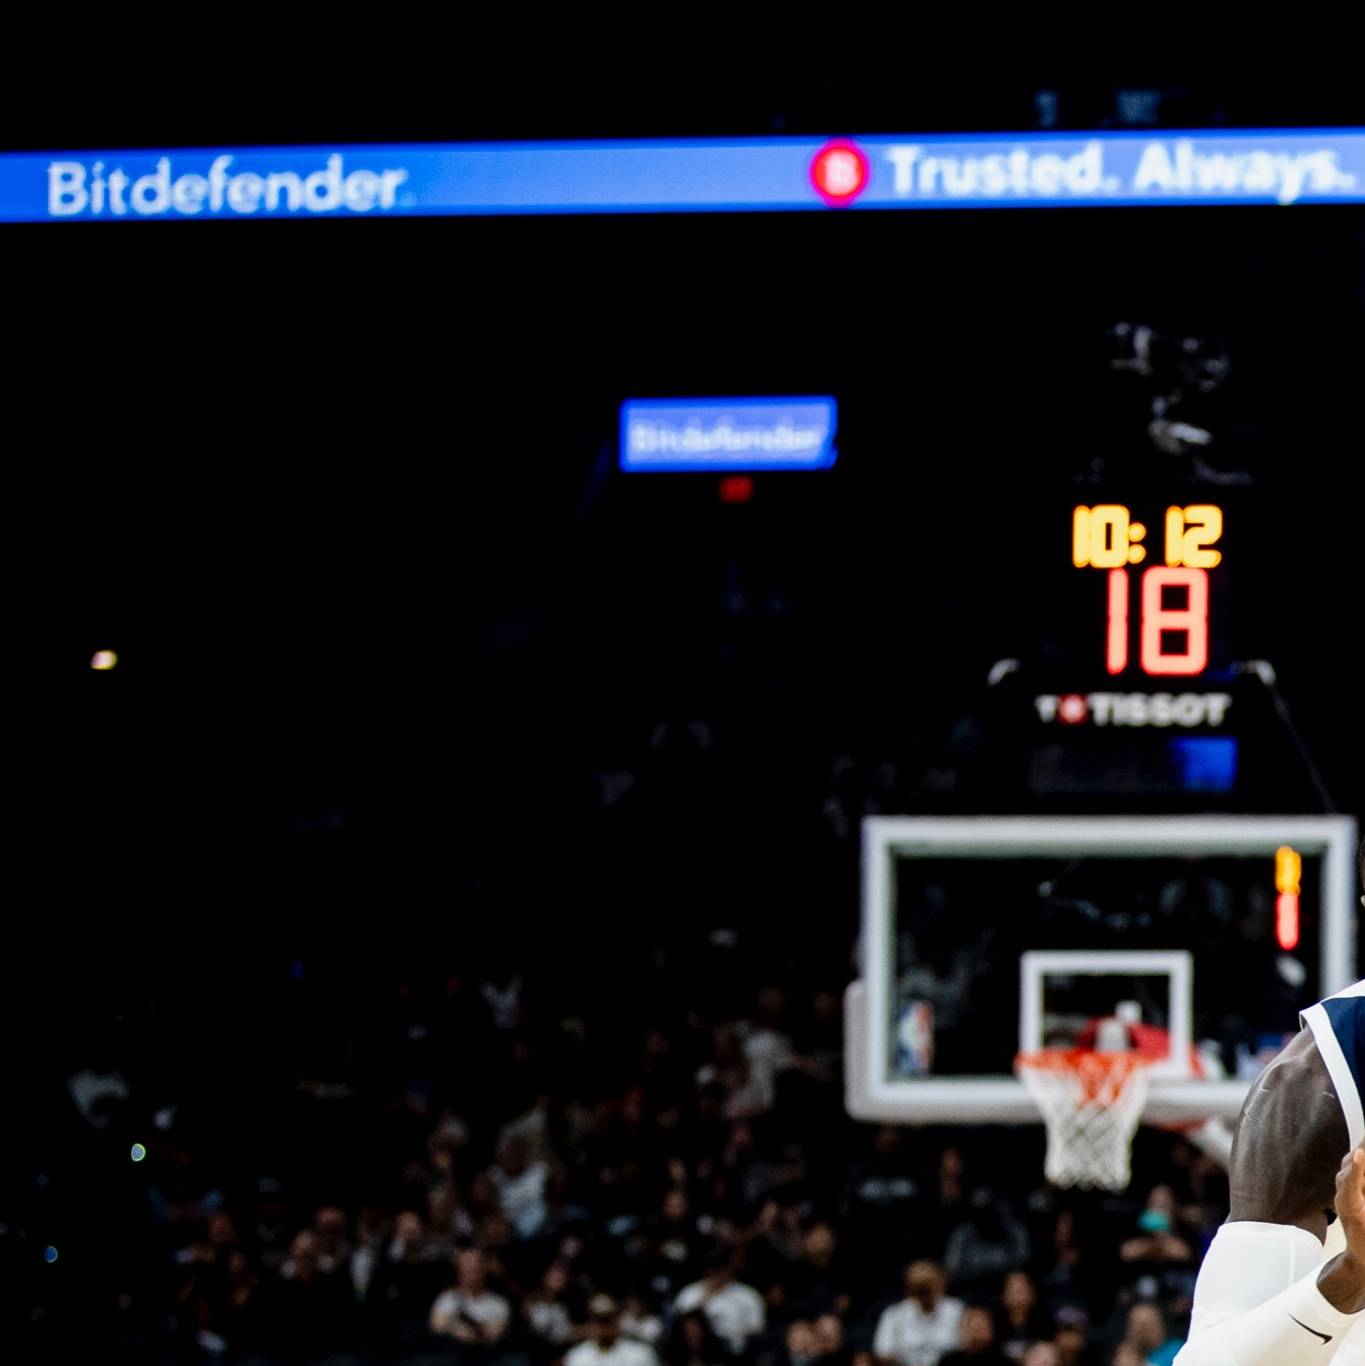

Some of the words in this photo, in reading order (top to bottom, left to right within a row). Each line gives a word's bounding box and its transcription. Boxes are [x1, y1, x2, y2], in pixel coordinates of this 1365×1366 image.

[48, 153, 408, 216] Bitdefender
[887, 140, 1120, 196] Trusted.
[1131, 138, 1358, 206] Always.
[1106, 565, 1209, 676] 18
[1086, 692, 1233, 727] TISSOT
